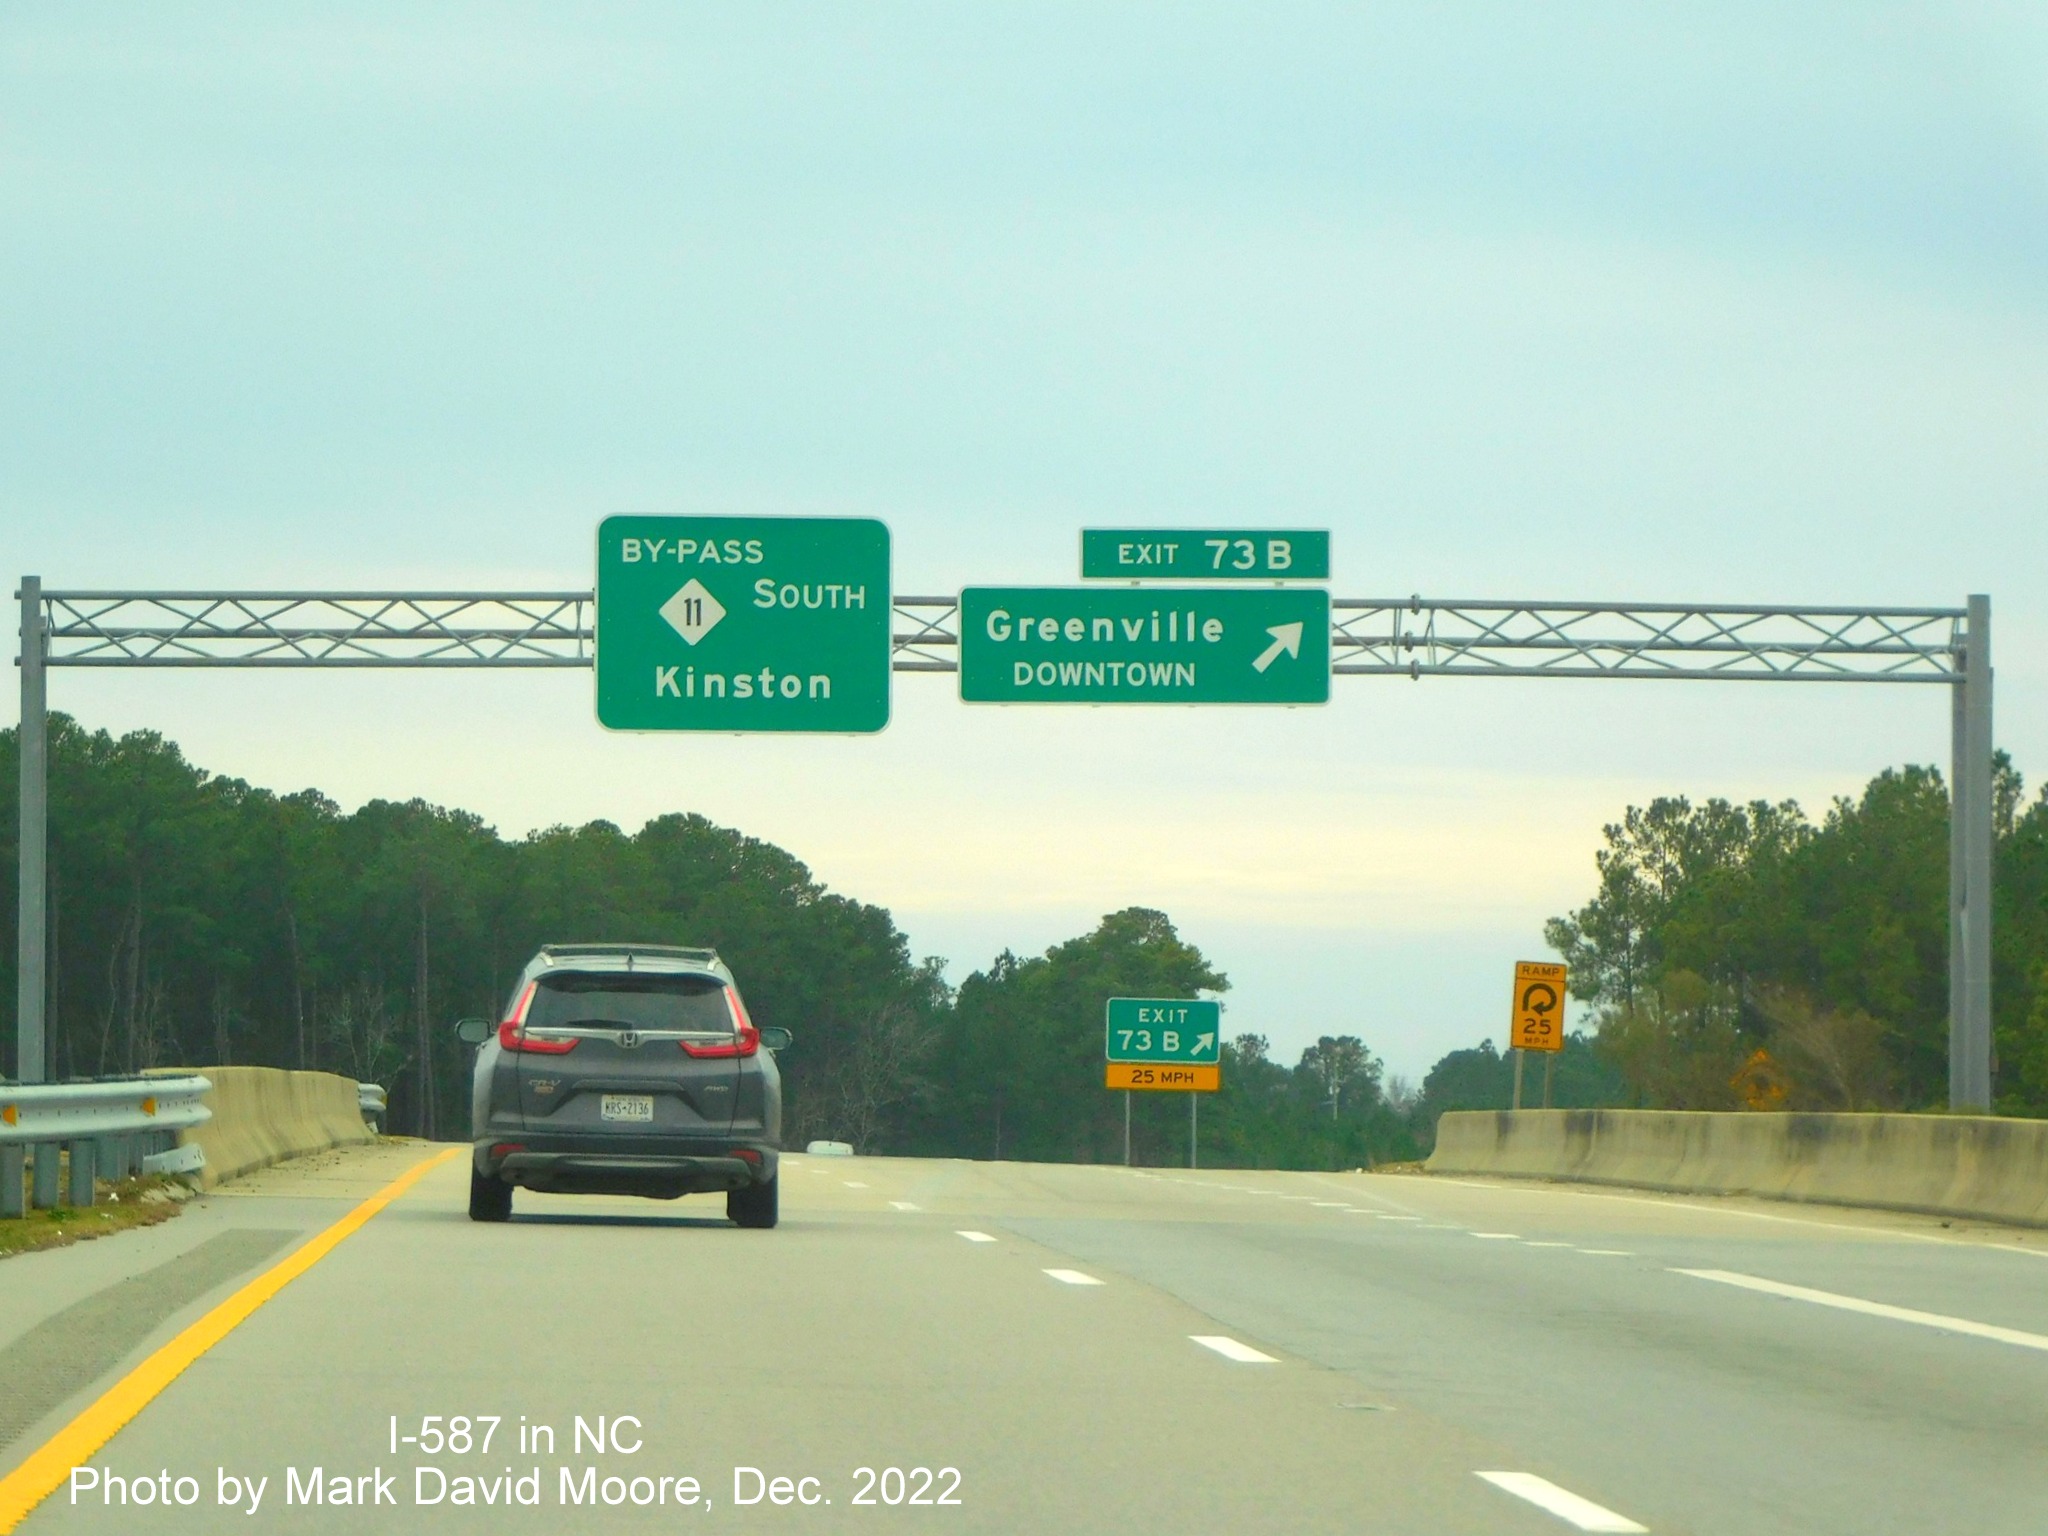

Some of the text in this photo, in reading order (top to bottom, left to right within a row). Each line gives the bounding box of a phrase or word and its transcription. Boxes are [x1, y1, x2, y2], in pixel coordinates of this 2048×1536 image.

[622, 538, 764, 564] BY-PASS
[1118, 544, 1179, 564] EXIT
[684, 597, 702, 627] 11
[986, 610, 1224, 643] Greenville
[656, 666, 831, 698] Kinston
[1013, 662, 1195, 687] DOWNTOWN
[1522, 965, 1560, 977] RAMP
[1138, 1008, 1188, 1023] EXIT
[1523, 1018, 1551, 1035] 25
[1524, 1037, 1549, 1045] MPH
[1131, 1069, 1194, 1084] 25 MPH
